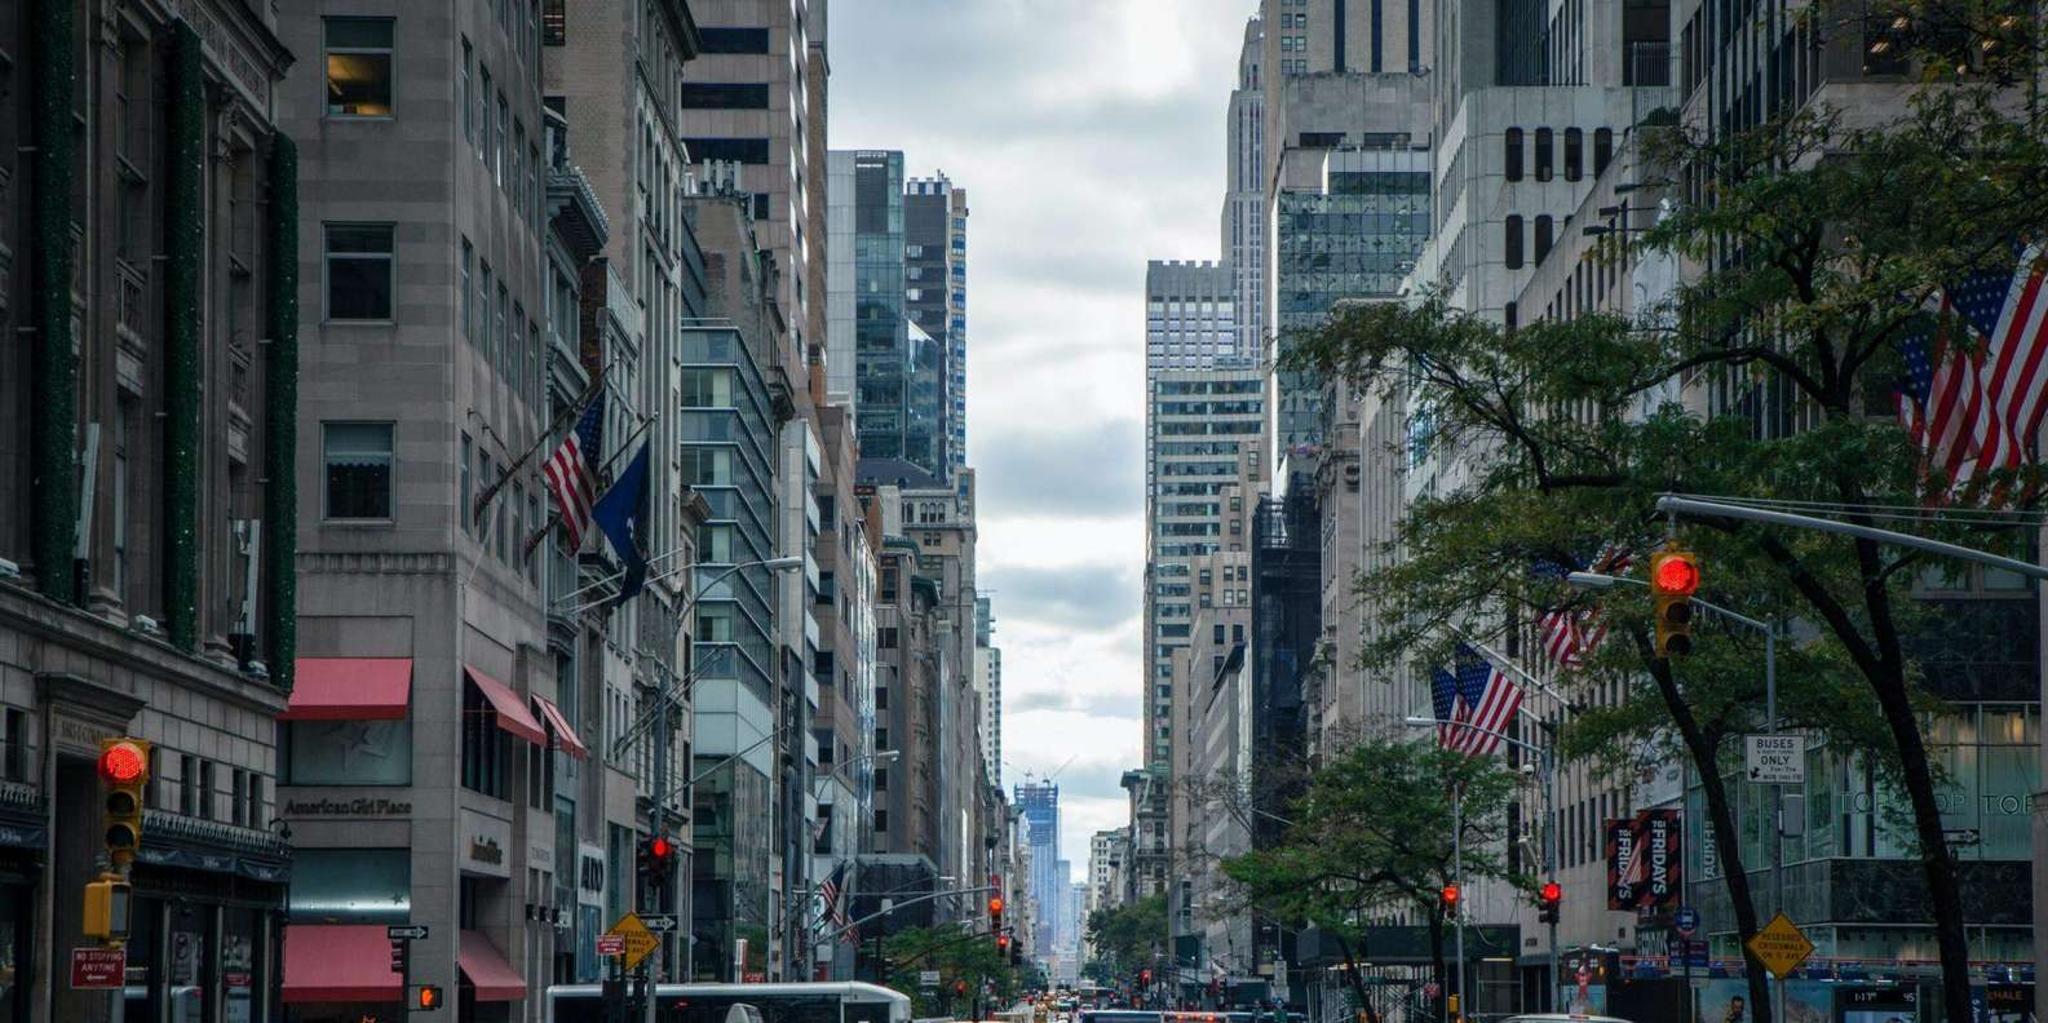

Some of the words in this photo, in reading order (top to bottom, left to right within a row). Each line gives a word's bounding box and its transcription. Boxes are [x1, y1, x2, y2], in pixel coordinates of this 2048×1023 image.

[1757, 739, 1794, 748] BUSES
[1761, 756, 1790, 765] ONLY
[285, 798, 349, 815] American
[350, 799, 375, 815] Girl
[377, 800, 412, 814] Place
[1652, 829, 1667, 894] FRIDAYS
[81, 963, 116, 972] ANYTIME
